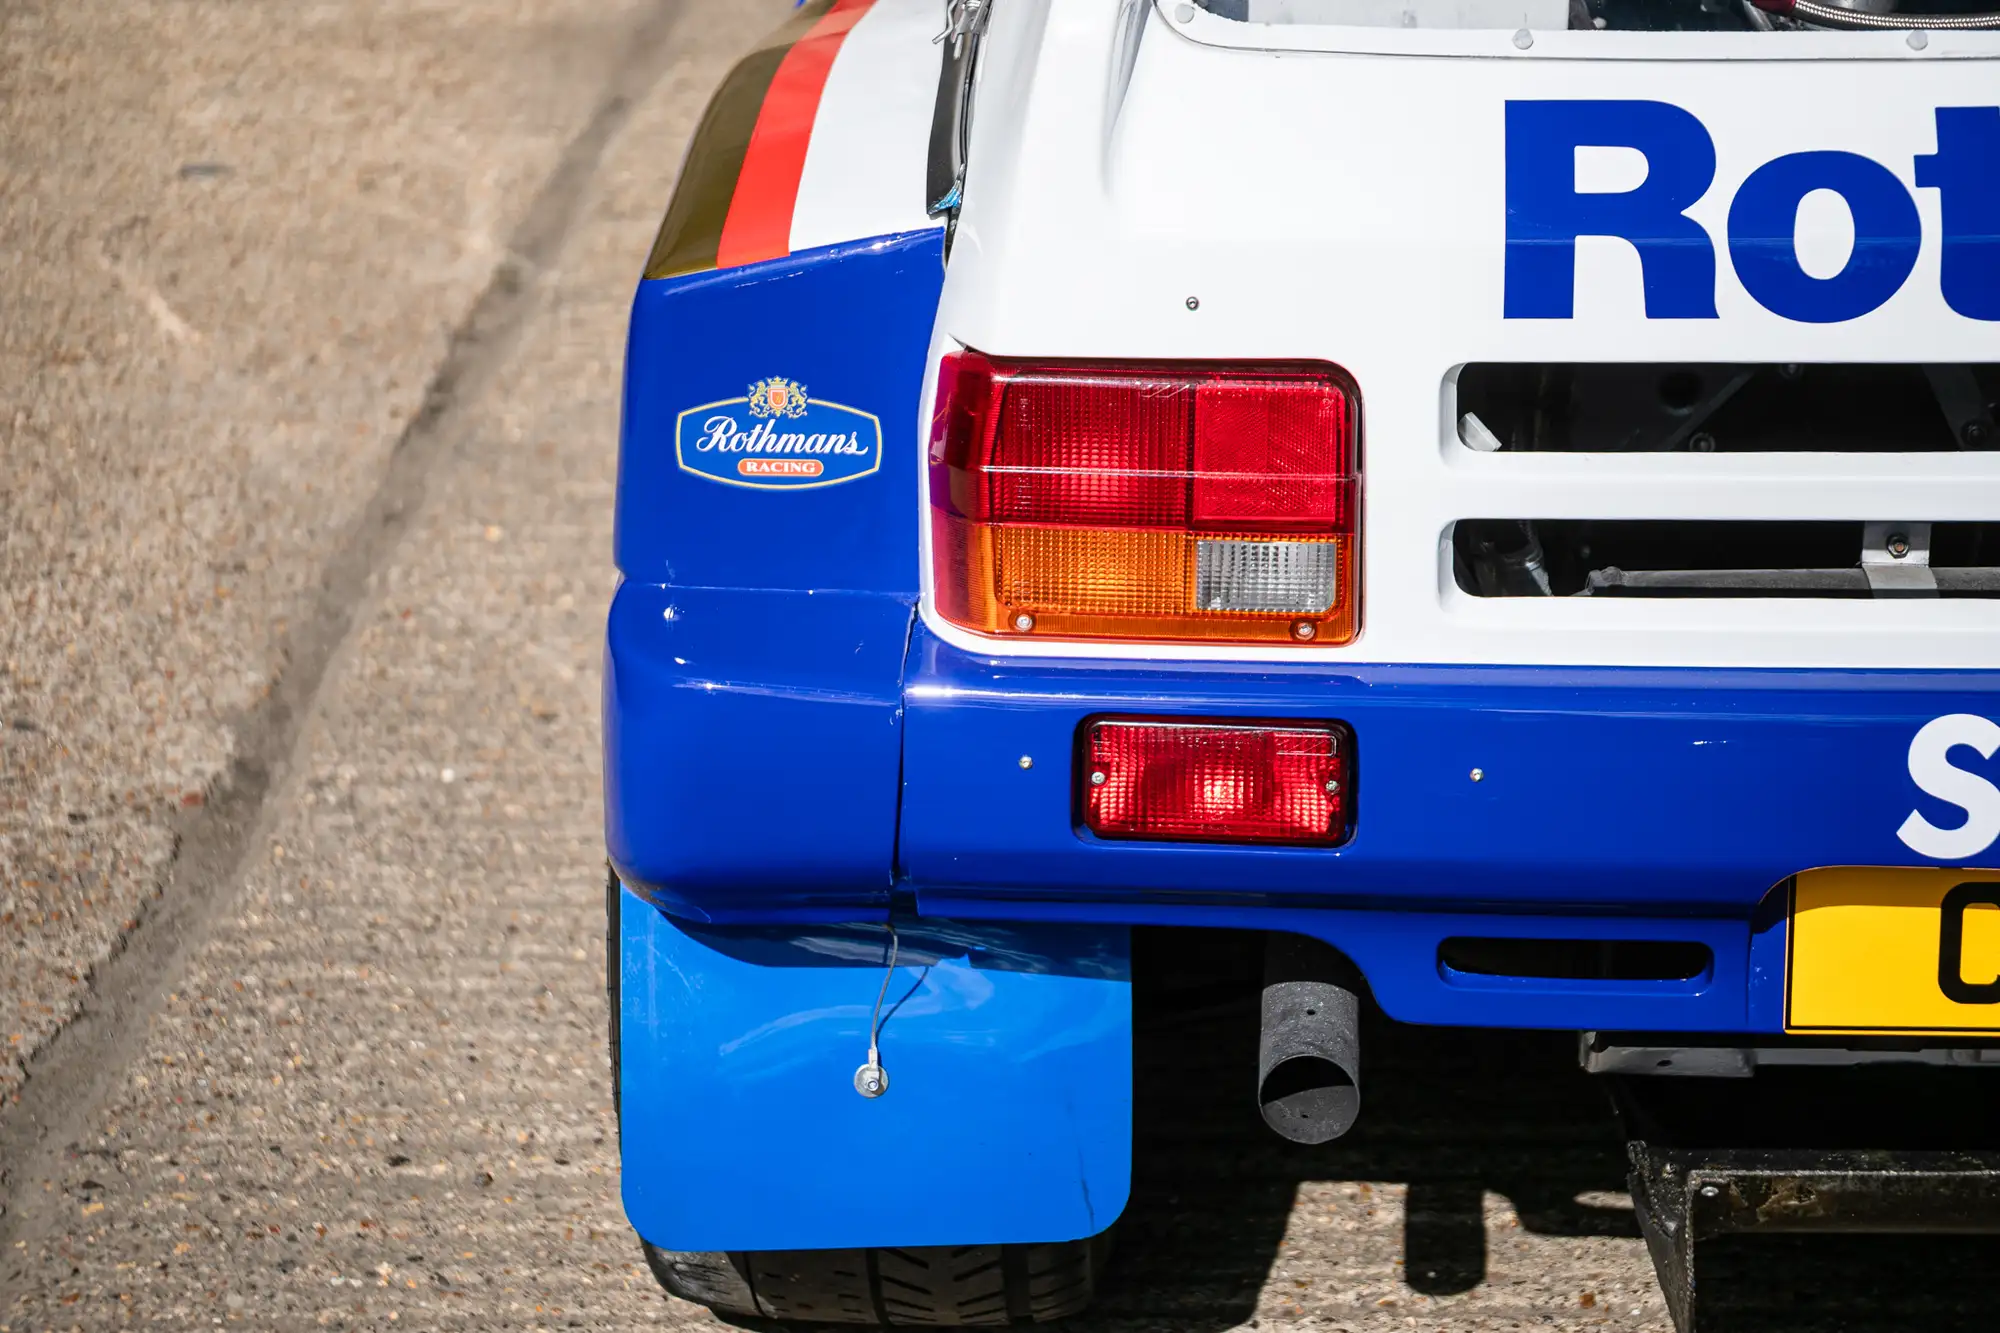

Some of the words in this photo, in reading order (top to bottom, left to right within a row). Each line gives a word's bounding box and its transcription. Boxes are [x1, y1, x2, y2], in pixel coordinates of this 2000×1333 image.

[696, 416, 869, 455] Rothmans
[746, 461, 815, 474] RACING
[1896, 713, 2000, 859] S
[1938, 882, 2000, 1004] C
